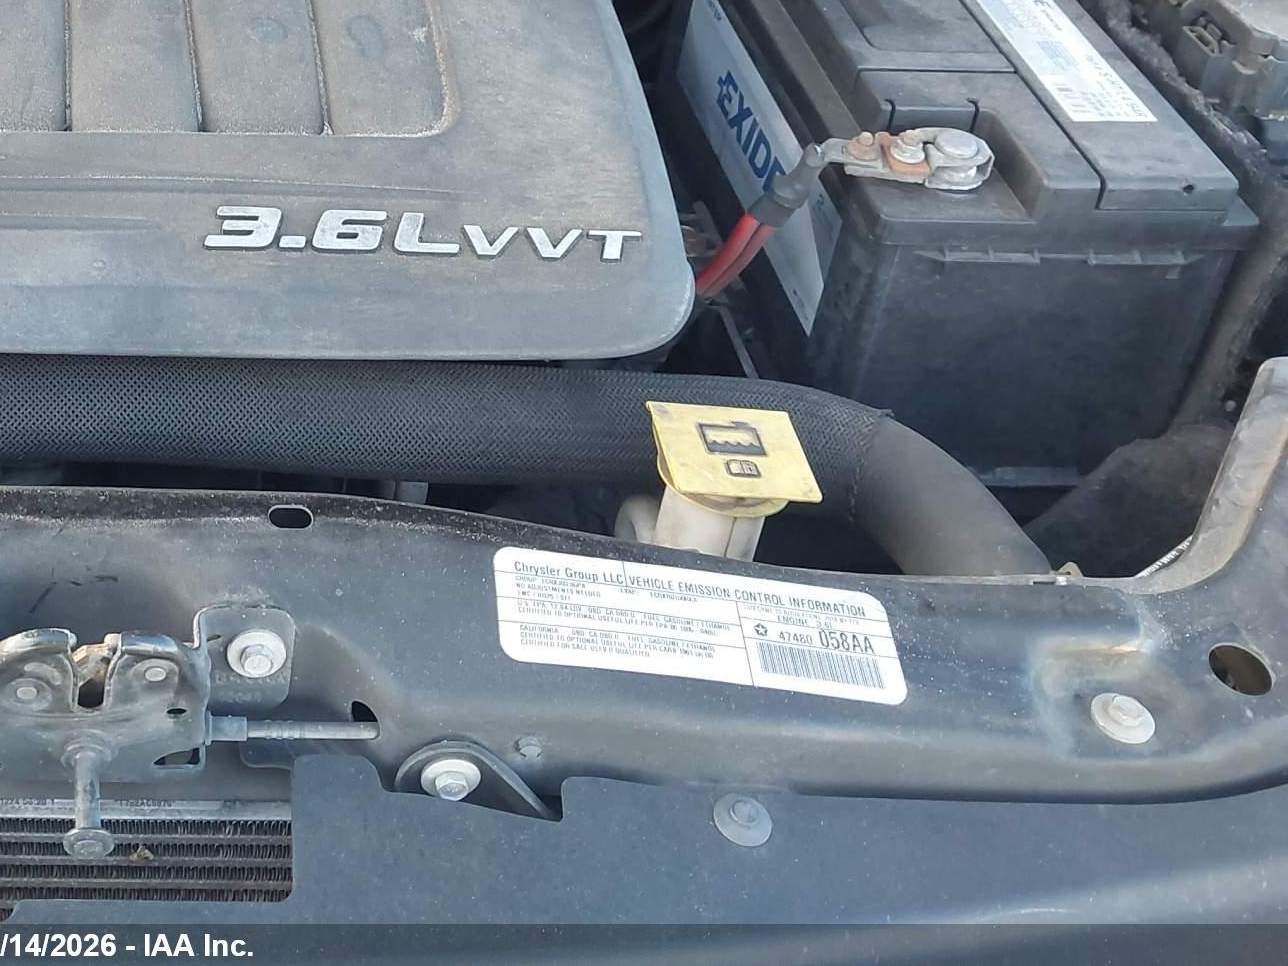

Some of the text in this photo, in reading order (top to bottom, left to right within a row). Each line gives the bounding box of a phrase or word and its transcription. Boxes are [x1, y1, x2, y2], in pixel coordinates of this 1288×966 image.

[463, 224, 643, 262] VVT
[514, 561, 560, 576] Chrysler
[565, 567, 599, 583] Group
[602, 572, 623, 584] LLC
[629, 575, 674, 590] VEHICLE
[678, 582, 730, 598] EMISSION
[735, 590, 785, 606] CONTROL
[789, 597, 866, 617] INFORMATION
